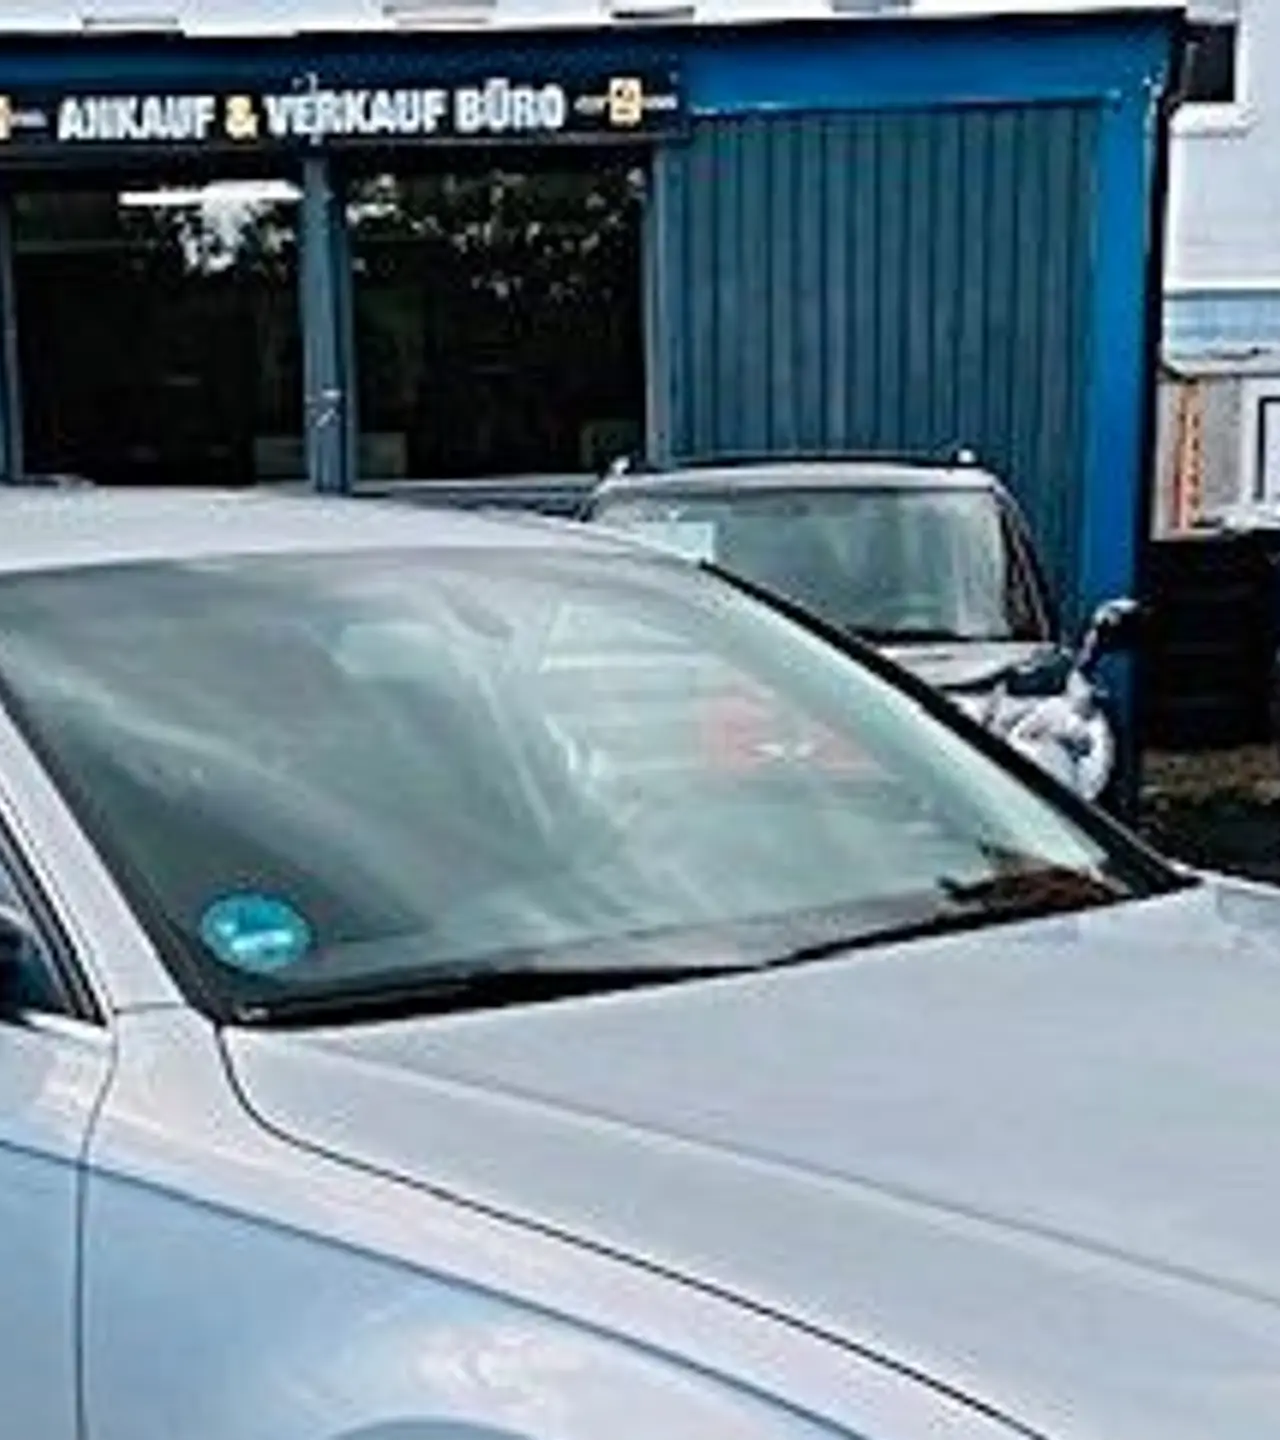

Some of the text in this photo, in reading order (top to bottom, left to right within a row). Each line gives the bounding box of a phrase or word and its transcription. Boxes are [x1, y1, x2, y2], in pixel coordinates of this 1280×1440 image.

[57, 95, 216, 140] ANKAUF
[225, 94, 258, 139] &
[262, 88, 448, 136] VERKAUF
[455, 77, 566, 133] BÜRO
